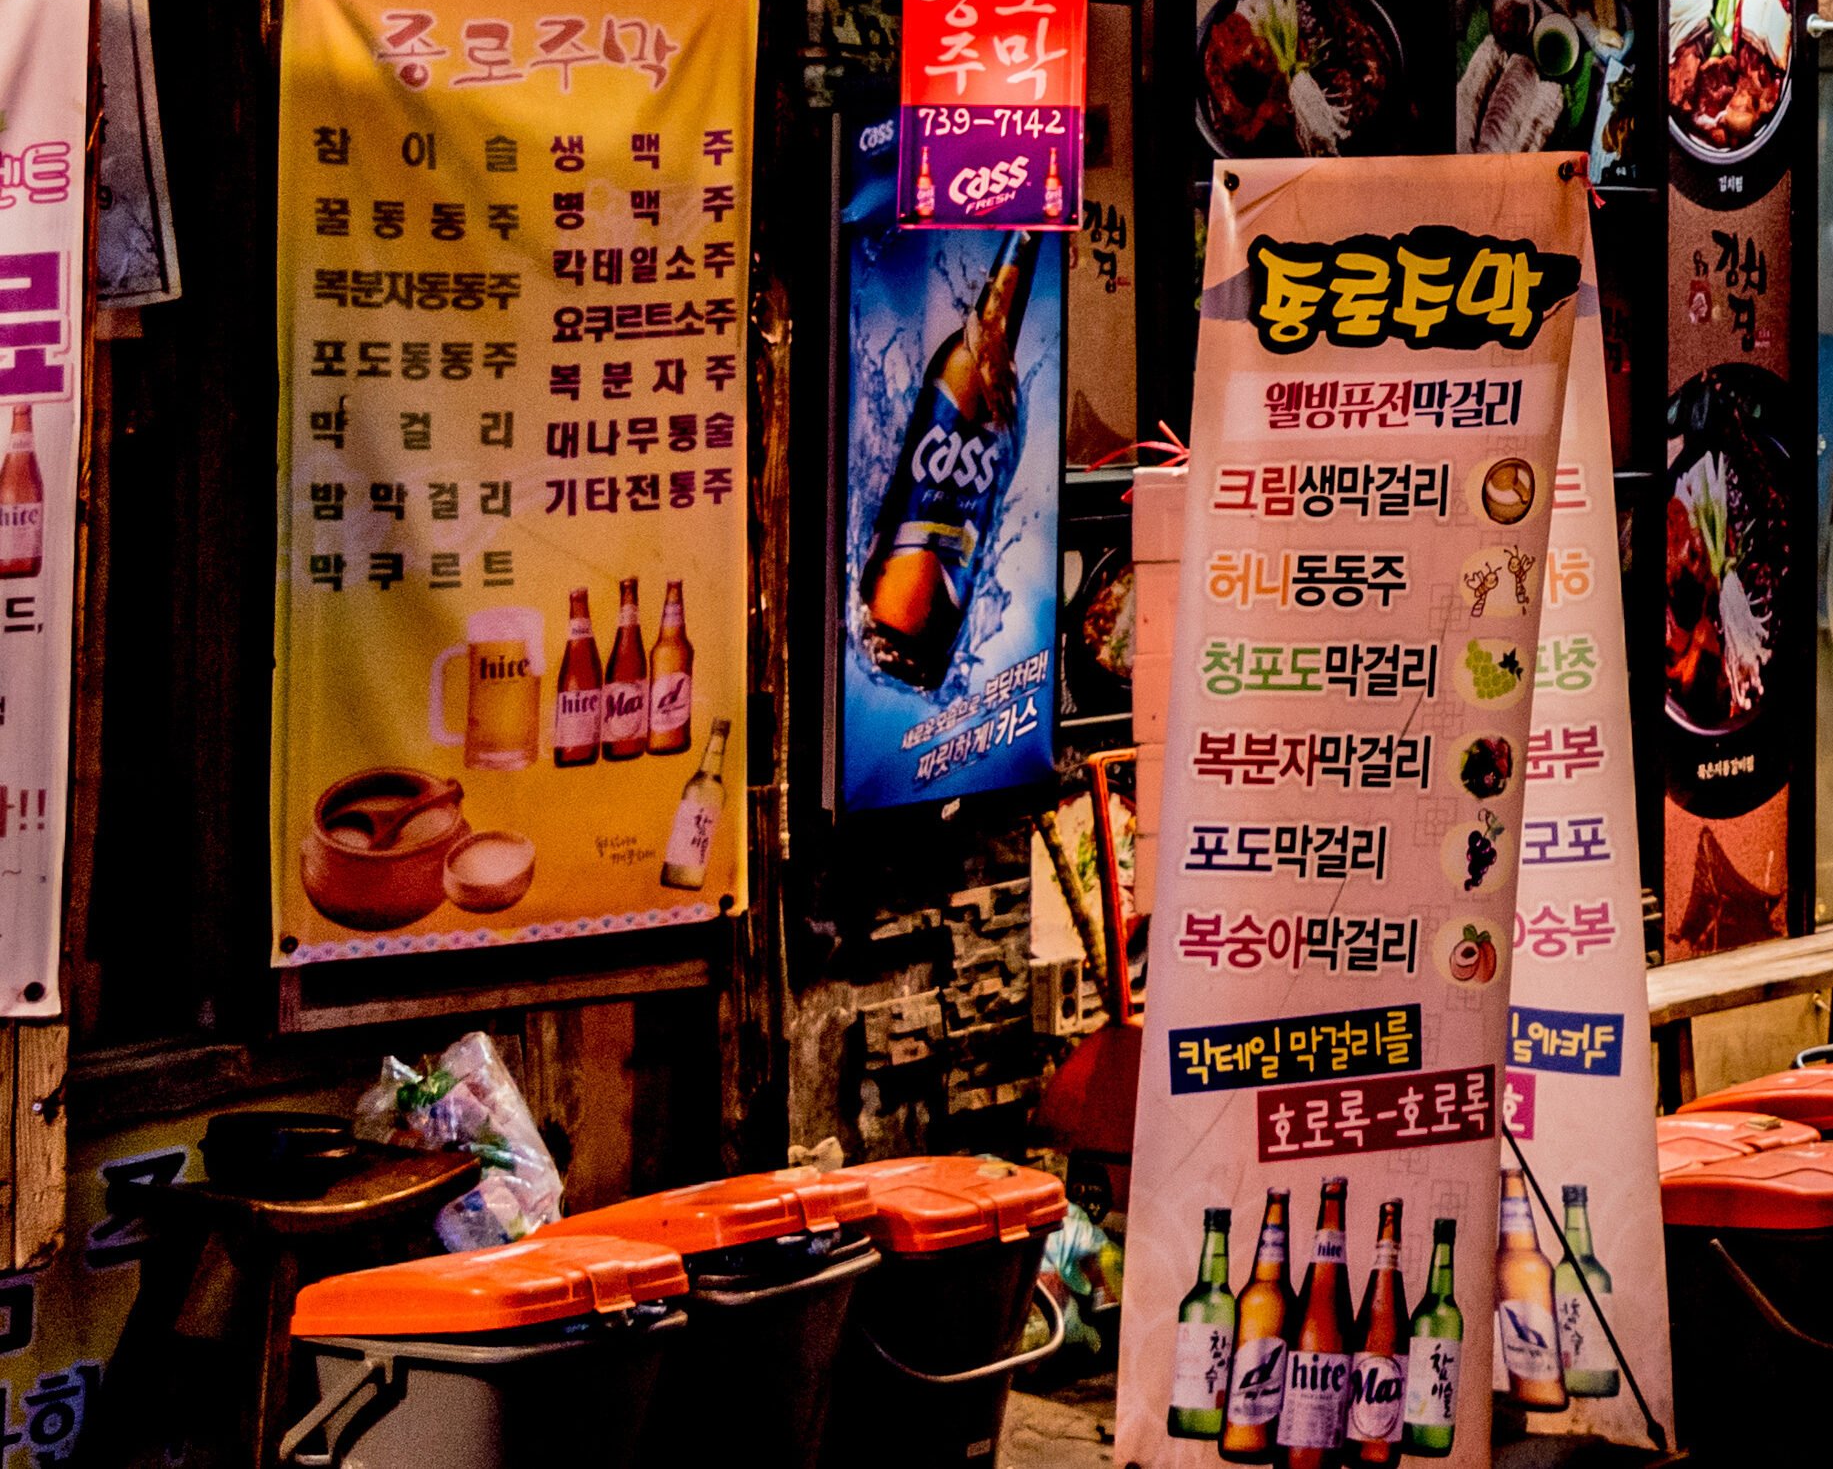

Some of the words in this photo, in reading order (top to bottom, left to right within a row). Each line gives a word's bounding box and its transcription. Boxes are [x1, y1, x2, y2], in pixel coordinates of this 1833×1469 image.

[377, 12, 677, 91] 종로주막
[925, 33, 1068, 101] 주막
[919, 107, 1066, 137] 739-7142
[313, 127, 518, 172] 참이슬
[549, 129, 733, 173] 생맥주
[949, 156, 1029, 200] Cass
[965, 191, 1019, 214] FRESH
[551, 185, 734, 229] 병맥주
[313, 269, 521, 311] 복분자동동주
[310, 340, 517, 381] 포도동동주
[549, 355, 737, 401] 복분자주
[1264, 380, 1524, 429] 웰빙퓨전막걸리
[310, 410, 513, 450] 막걸리
[546, 411, 735, 460] 대나무통술
[911, 425, 998, 493] Cass
[545, 469, 733, 517] 기타전통주
[1212, 463, 1449, 517] 크림생막걸리
[1209, 555, 1406, 607] 허니동동주
[1201, 639, 1436, 697] 청포도막걸리
[994, 697, 1038, 746] 카스
[1194, 732, 1431, 789] 복분자막걸리
[1185, 824, 1386, 879] 포도막걸리
[1178, 914, 1418, 973] 복숭아막걸리
[1179, 1028, 1280, 1082] 칵테일
[1289, 1012, 1413, 1070] 막걸리를
[1268, 1071, 1489, 1154] 호로록-호로록
[1292, 1353, 1347, 1393] hite
